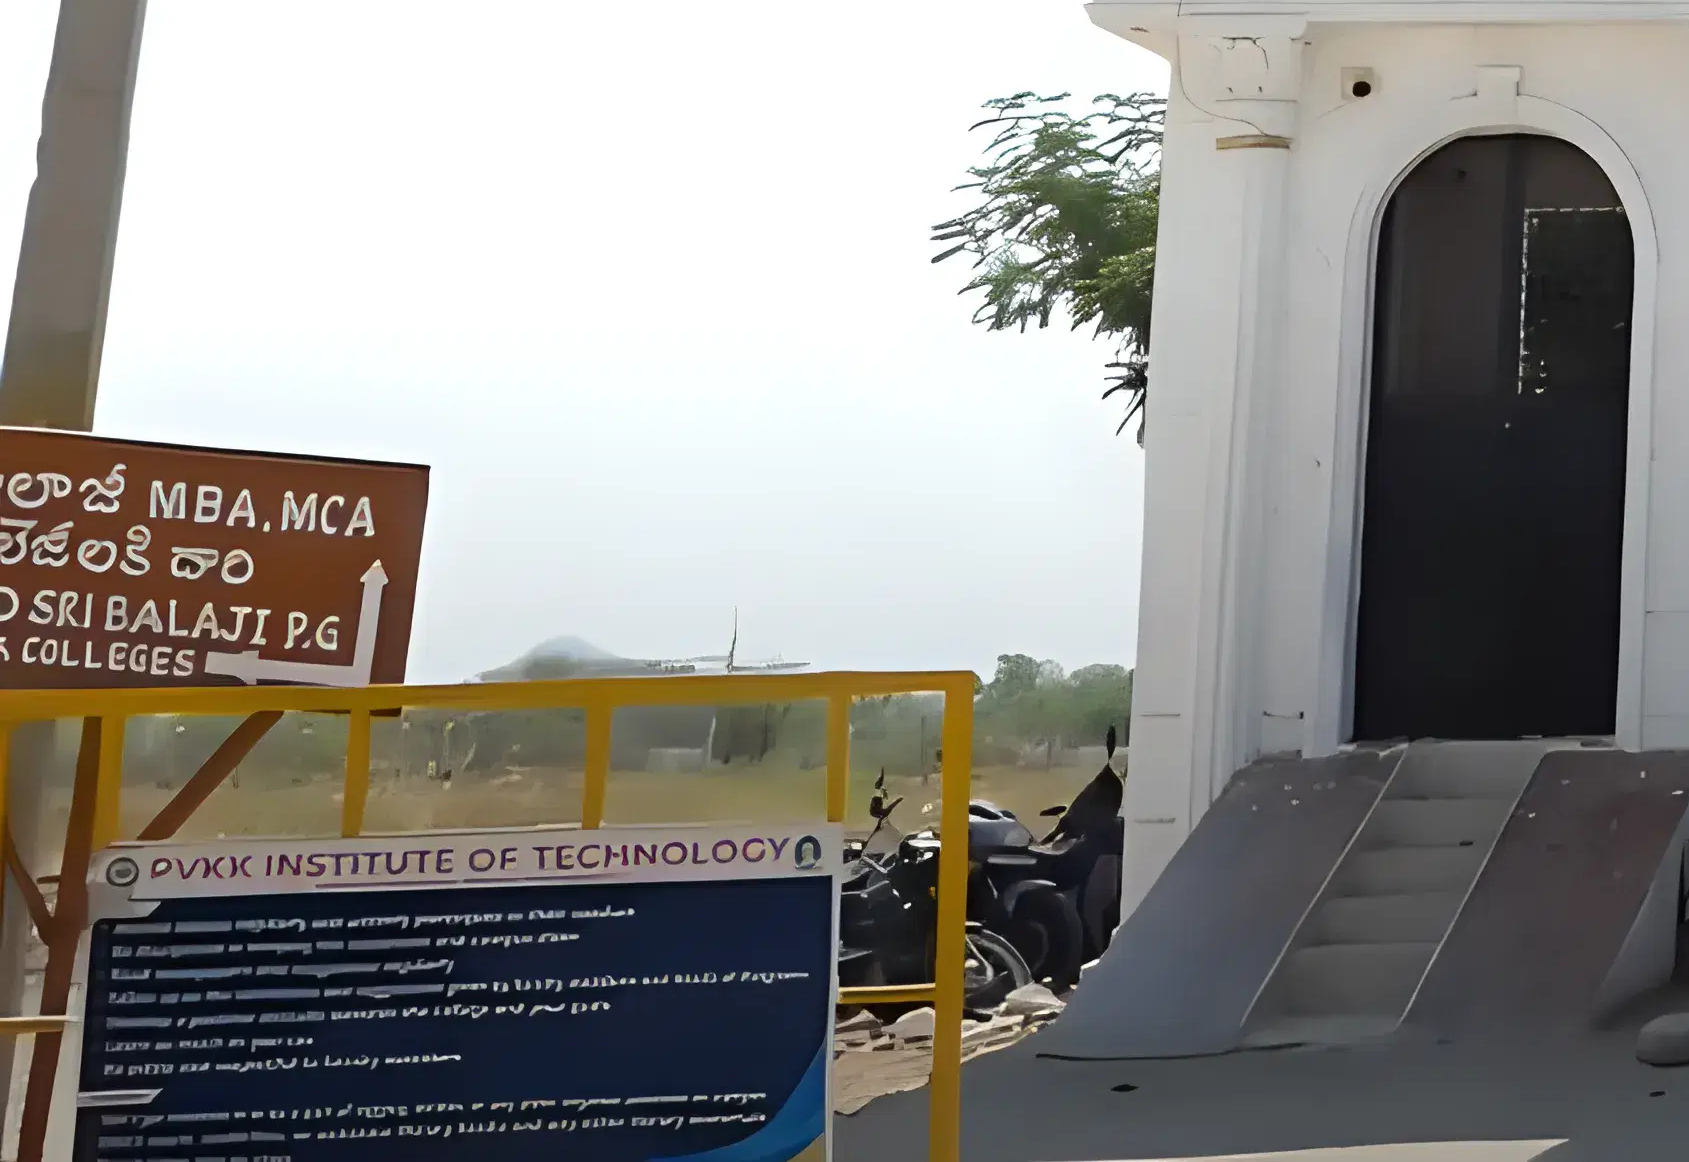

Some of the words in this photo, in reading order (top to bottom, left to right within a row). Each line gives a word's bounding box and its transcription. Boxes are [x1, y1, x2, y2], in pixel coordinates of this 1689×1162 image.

[0, 463, 127, 514] లాజీ
[27, 589, 94, 629] SRI
[104, 594, 272, 645] BALAJI
[21, 635, 196, 677] COLLEGES
[150, 853, 253, 881] PVKK
[263, 848, 455, 878] INSTITUTE
[467, 846, 519, 874] OF
[531, 836, 791, 872] TECHNOLOGY
